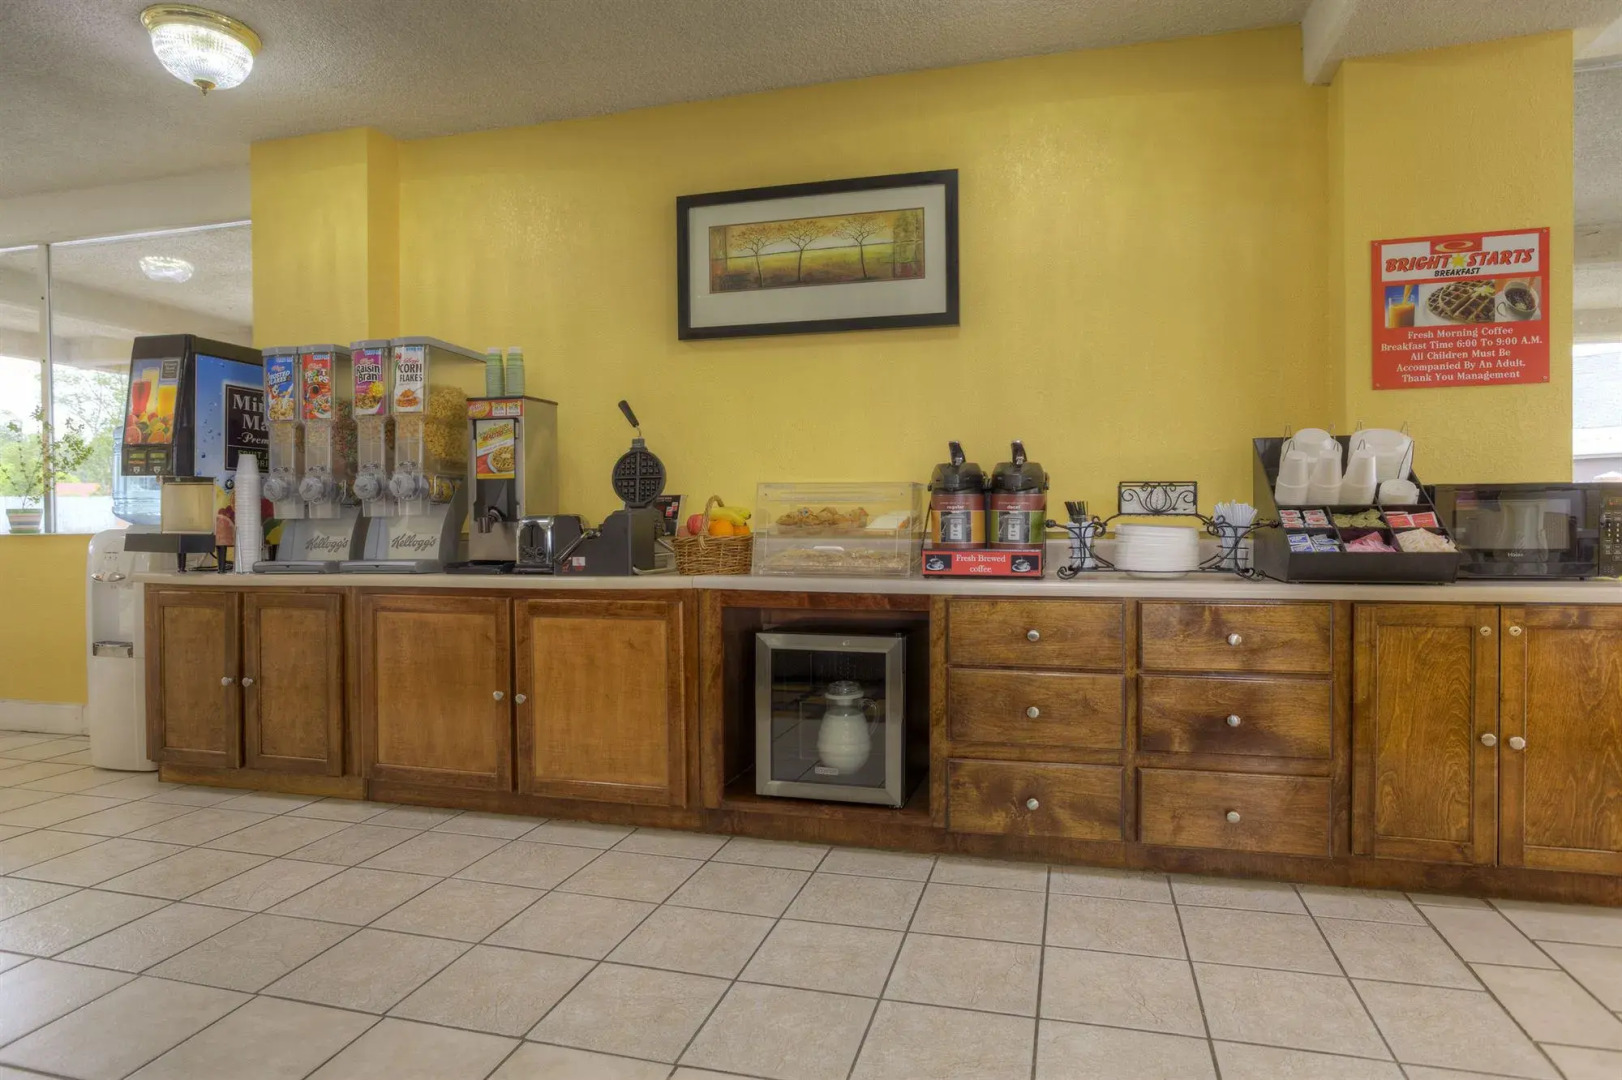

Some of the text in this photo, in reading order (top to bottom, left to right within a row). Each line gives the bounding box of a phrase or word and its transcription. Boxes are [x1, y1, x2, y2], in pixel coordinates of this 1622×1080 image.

[1385, 248, 1535, 273] BRIGHT STARTS
[1434, 267, 1481, 277] BREAKFAST
[1408, 326, 1513, 339] Fresh Morning Coffee
[1381, 335, 1543, 351] Breakfast Time 6:00 To 9:00 A.M.
[1411, 348, 1511, 360] All Children Must Be
[356, 365, 381, 375] Raisin
[398, 364, 422, 373] CORN
[1396, 358, 1526, 372] Accompanied By An Adult.
[359, 373, 378, 382] Bran
[400, 374, 423, 382] FLAKES
[1401, 370, 1520, 383] Thank You Management
[305, 535, 349, 552] Kellogg's
[391, 533, 437, 550] Kellogg's
[956, 554, 1006, 563] Fresh Brewed
[969, 564, 992, 573] coffee
